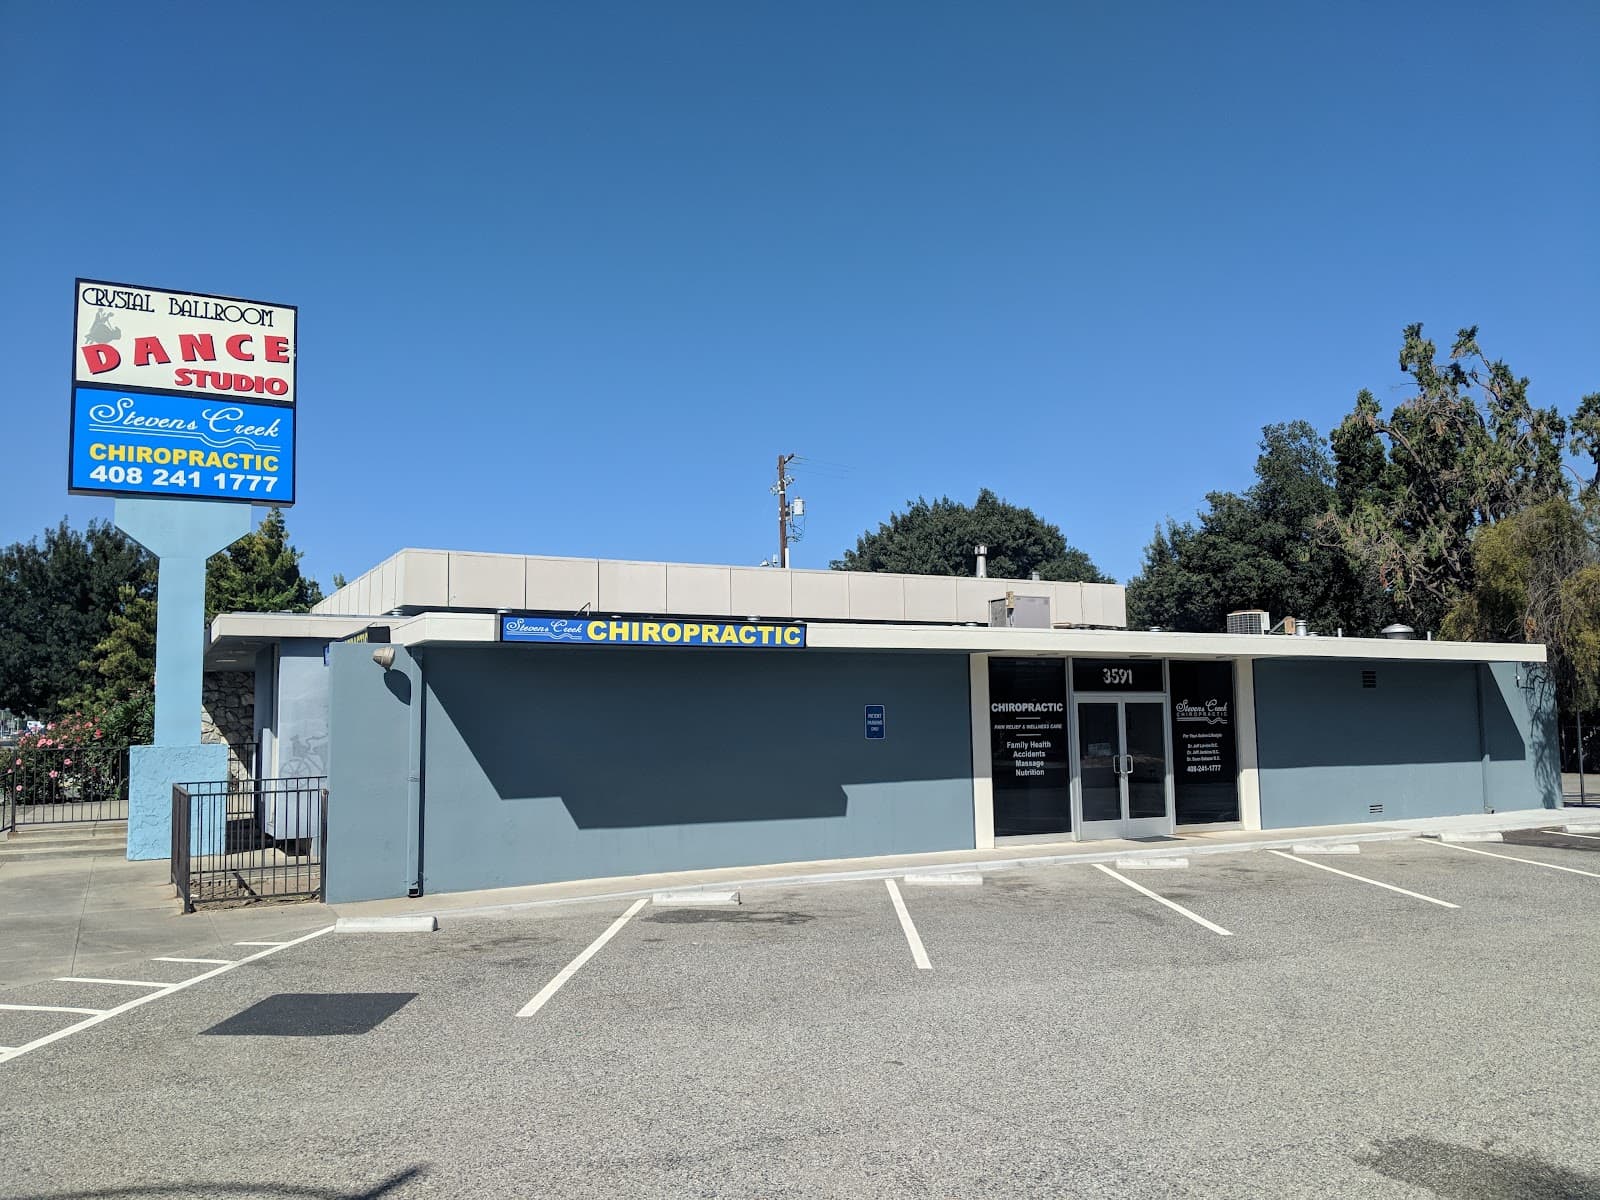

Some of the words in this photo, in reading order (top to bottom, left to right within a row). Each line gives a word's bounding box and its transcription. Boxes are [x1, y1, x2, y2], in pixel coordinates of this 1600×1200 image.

[82, 287, 154, 312] CRYSTAL
[168, 297, 274, 327] BALLROOM
[81, 333, 290, 375] DANCE
[174, 368, 288, 396] STUDIO
[89, 397, 198, 430] Stevens
[202, 407, 281, 438] Creek
[89, 443, 279, 472] CHIROPRACTIC
[89, 465, 142, 484] 408
[152, 468, 200, 488] 241
[214, 473, 278, 493] 1777
[506, 618, 549, 632] Stevens
[550, 619, 582, 632] Creek
[586, 620, 801, 646] CHIROPRACTIC
[1102, 668, 1133, 685] 3591
[991, 702, 1064, 712] CHIROPRACTIC
[1176, 699, 1204, 712] Stevens
[1007, 742, 1029, 750] Family
[1016, 760, 1044, 768] Massage
